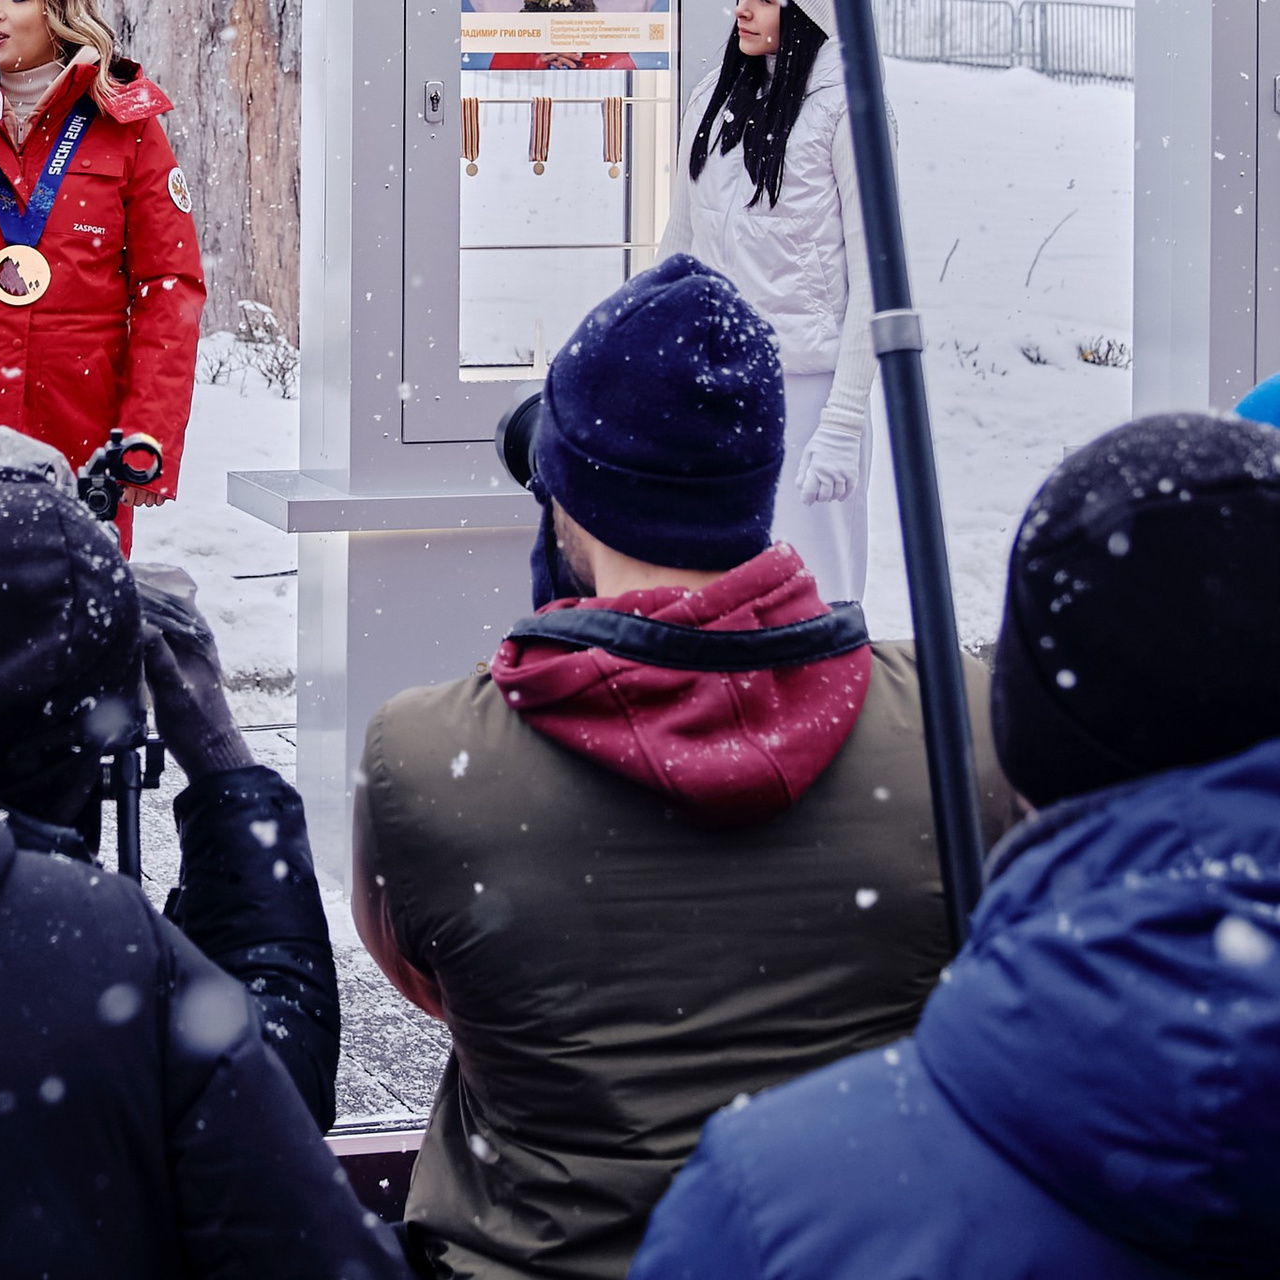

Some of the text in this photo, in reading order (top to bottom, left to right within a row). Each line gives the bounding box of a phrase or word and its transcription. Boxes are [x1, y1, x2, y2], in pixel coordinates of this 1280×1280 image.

[48, 115, 87, 176] SOCHI 2014
[72, 222, 107, 235] ZASPORT
